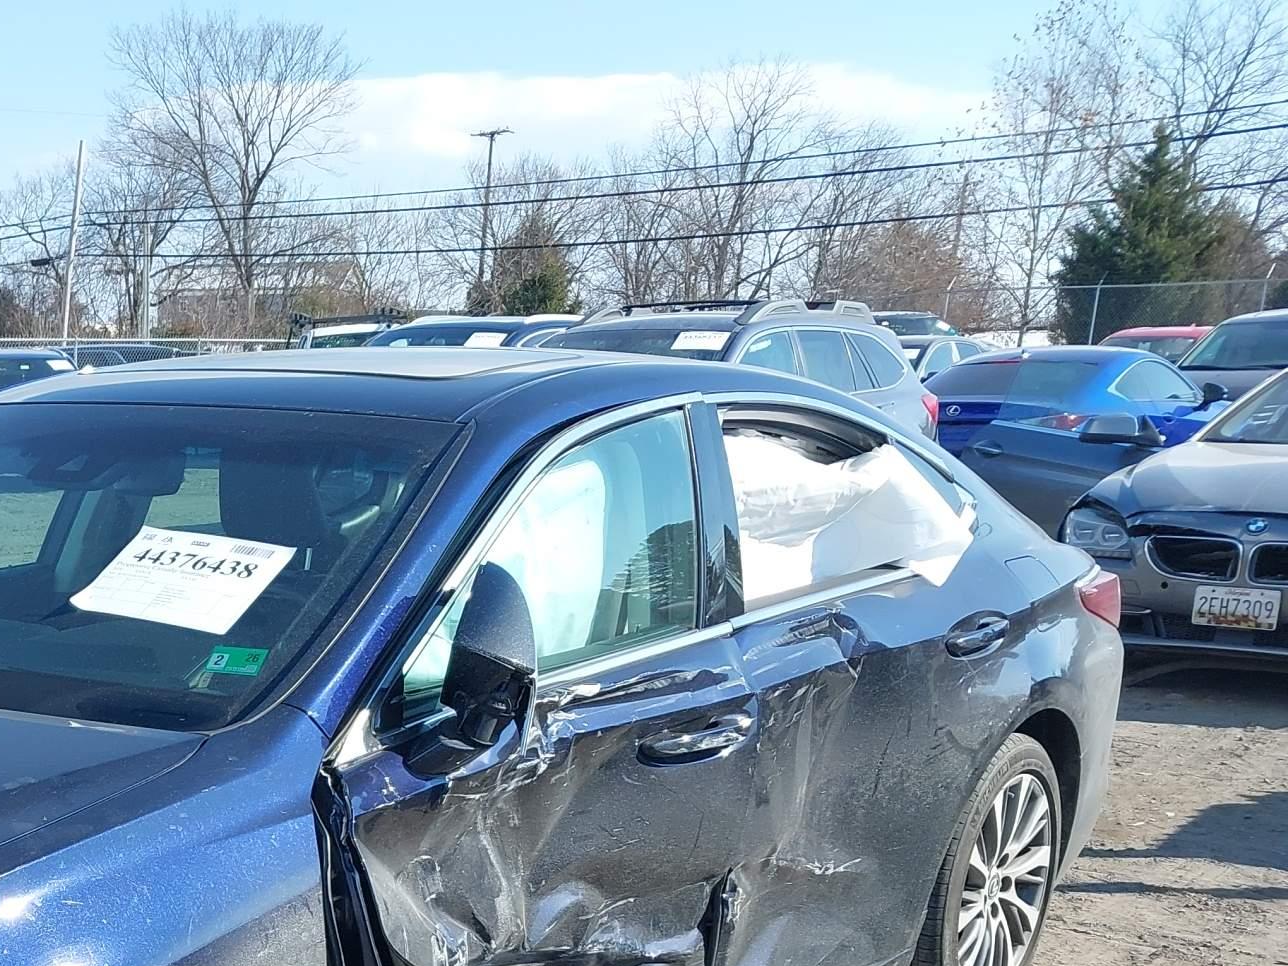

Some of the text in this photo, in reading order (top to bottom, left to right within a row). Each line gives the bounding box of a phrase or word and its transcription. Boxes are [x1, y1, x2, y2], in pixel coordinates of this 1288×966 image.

[132, 547, 259, 580] 44376438
[1197, 595, 1274, 620] 2EH7309
[213, 653, 261, 666] 2 26
